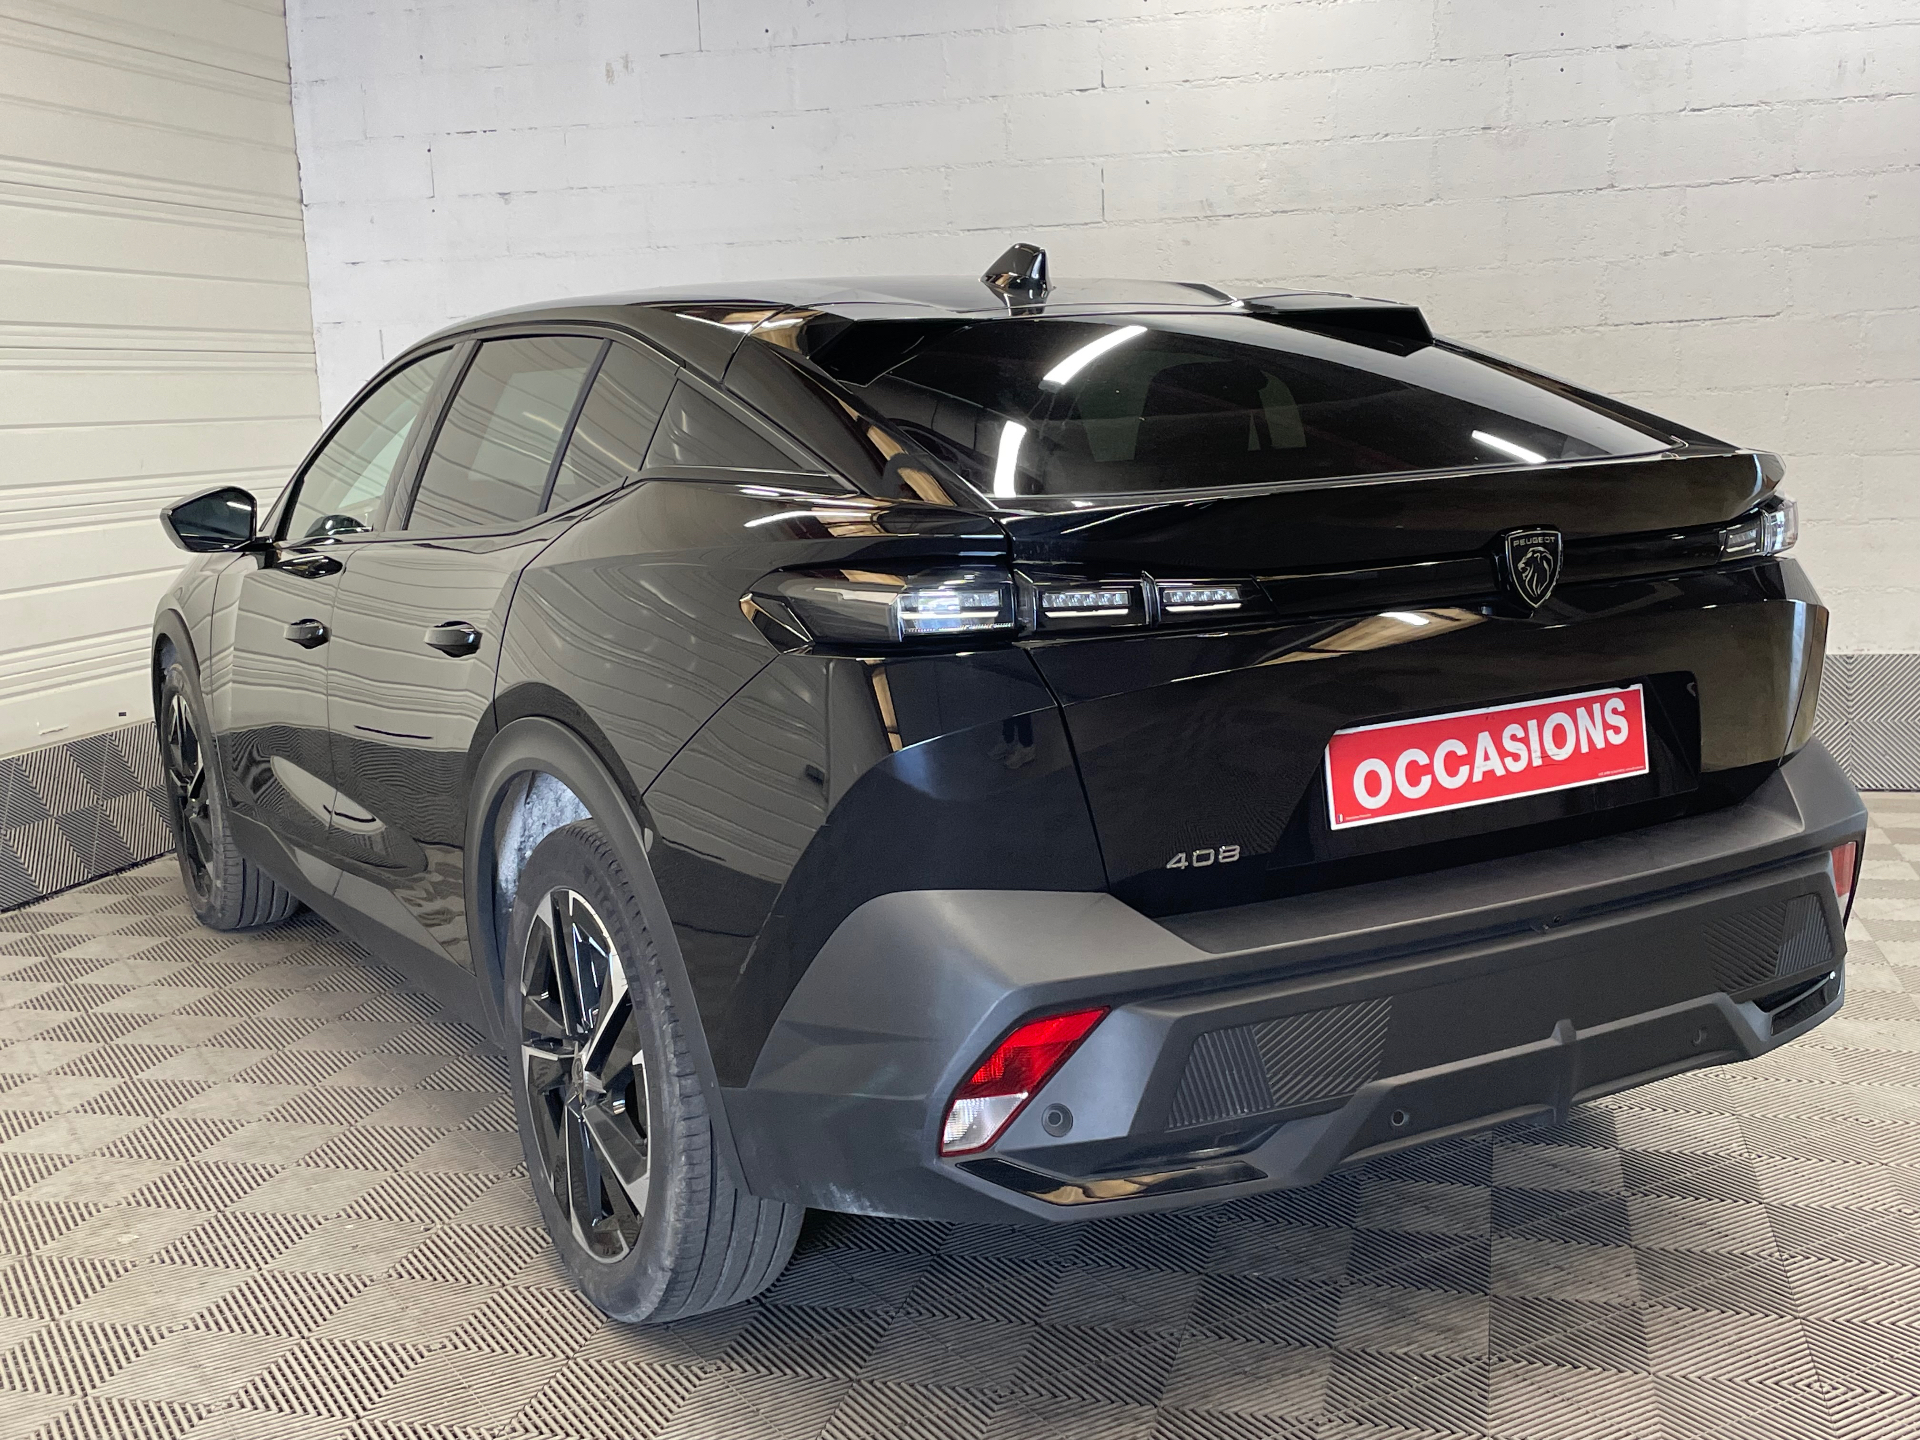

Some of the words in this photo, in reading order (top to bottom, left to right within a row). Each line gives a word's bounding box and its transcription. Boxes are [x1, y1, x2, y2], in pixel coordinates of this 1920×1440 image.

[1513, 536, 1556, 547] PEUGEOT
[1353, 697, 1629, 809] OCCASIONS
[1166, 845, 1240, 869] 408
